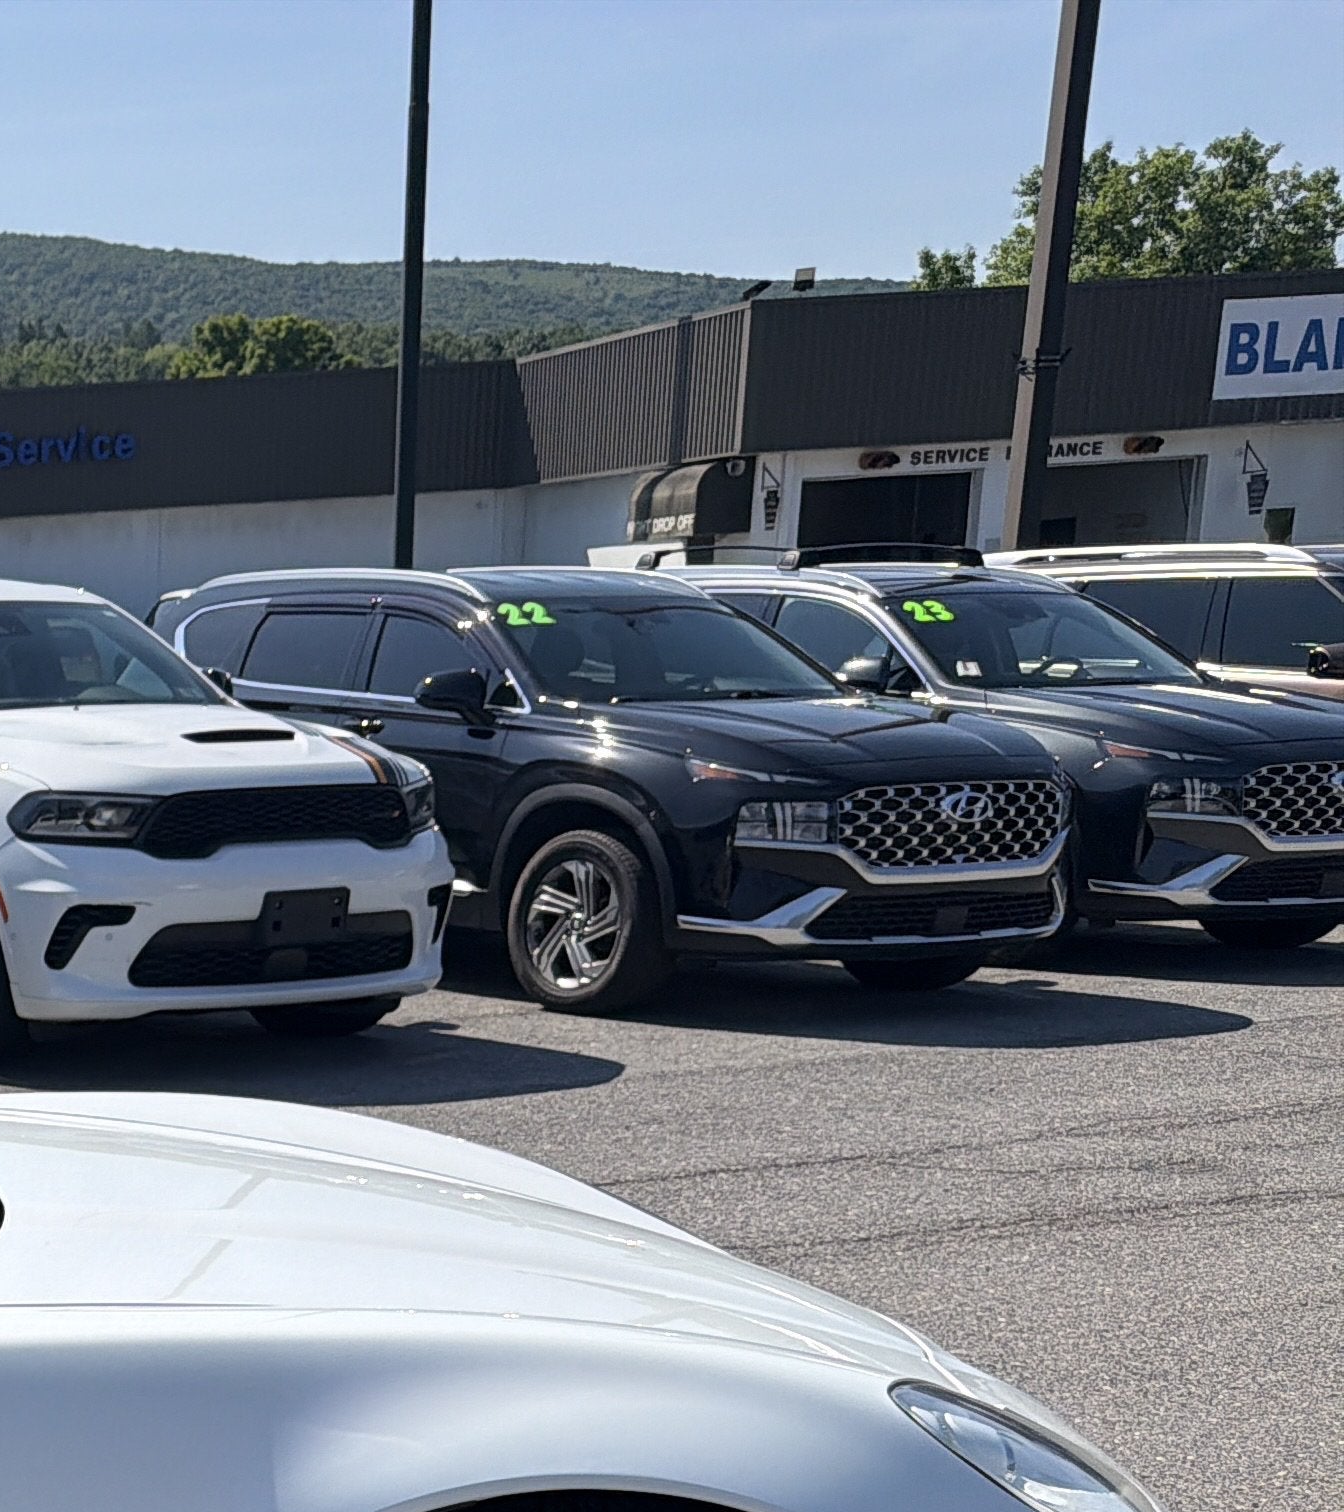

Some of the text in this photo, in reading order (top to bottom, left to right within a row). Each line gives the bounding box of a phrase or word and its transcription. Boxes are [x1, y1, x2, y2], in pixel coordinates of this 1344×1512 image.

[909, 447, 990, 466] SERVICE
[652, 516, 675, 534] DROP
[677, 512, 696, 531] OFF
[497, 602, 557, 627] 22
[902, 600, 955, 623] 23
